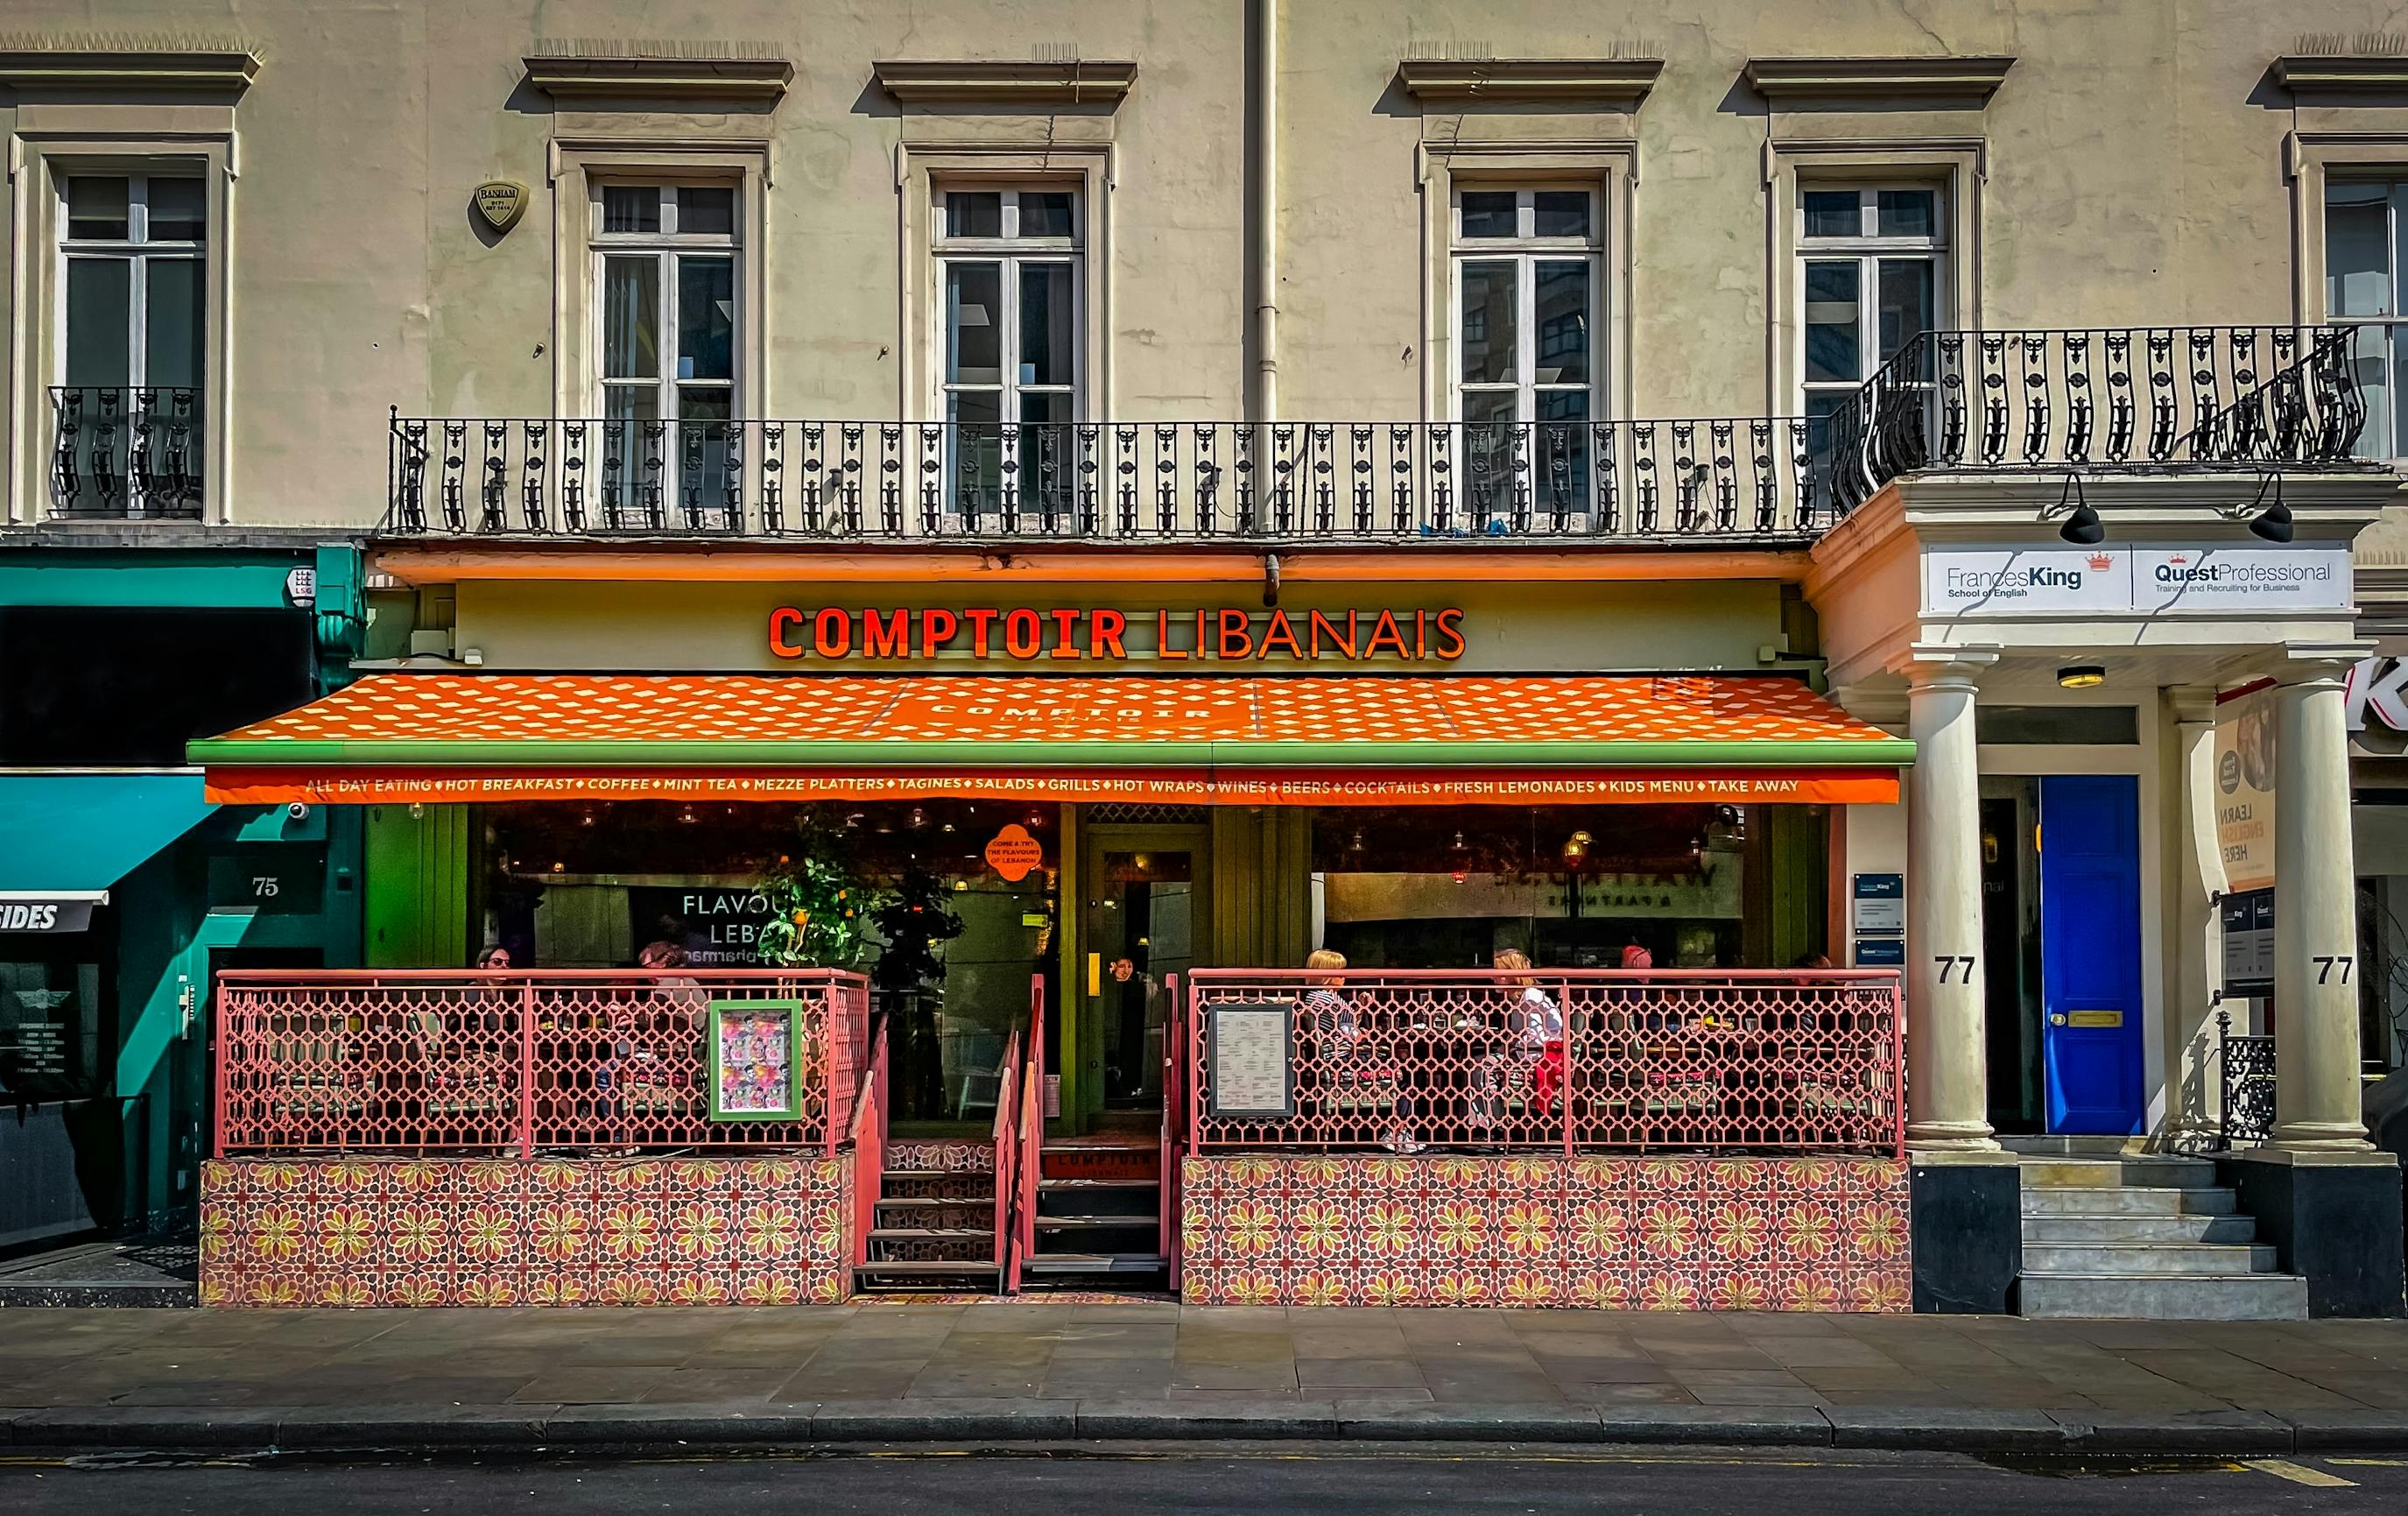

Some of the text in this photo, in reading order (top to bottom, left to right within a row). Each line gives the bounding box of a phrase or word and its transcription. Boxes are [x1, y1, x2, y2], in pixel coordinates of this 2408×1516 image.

[480, 189, 516, 199] BANHAM
[1947, 567, 2081, 590] FrancesKing
[2155, 563, 2331, 582] QuestProfessional
[1948, 589, 2027, 598] School of English
[2156, 583, 2300, 595] Training and Recruiting for Business
[768, 605, 1467, 661] COMPTOIR LIBANAIS
[931, 705, 1211, 718] COMPTOIR
[306, 778, 1799, 794] ALL DAY EATING HOT BREAKFAST COFFEE MINT TEA MEZZE PLATTERS TAGINES SALADS GRILLS HOT WRAPS WINES BEERS COCKTAILS FRESH LEMONADES KIDS MENU TAKE AWAY
[252, 878, 279, 896] 75
[683, 895, 788, 914] FLAVOU
[0, 905, 59, 929] IDES
[1934, 955, 1975, 984] 77
[2313, 956, 2353, 985] 77
